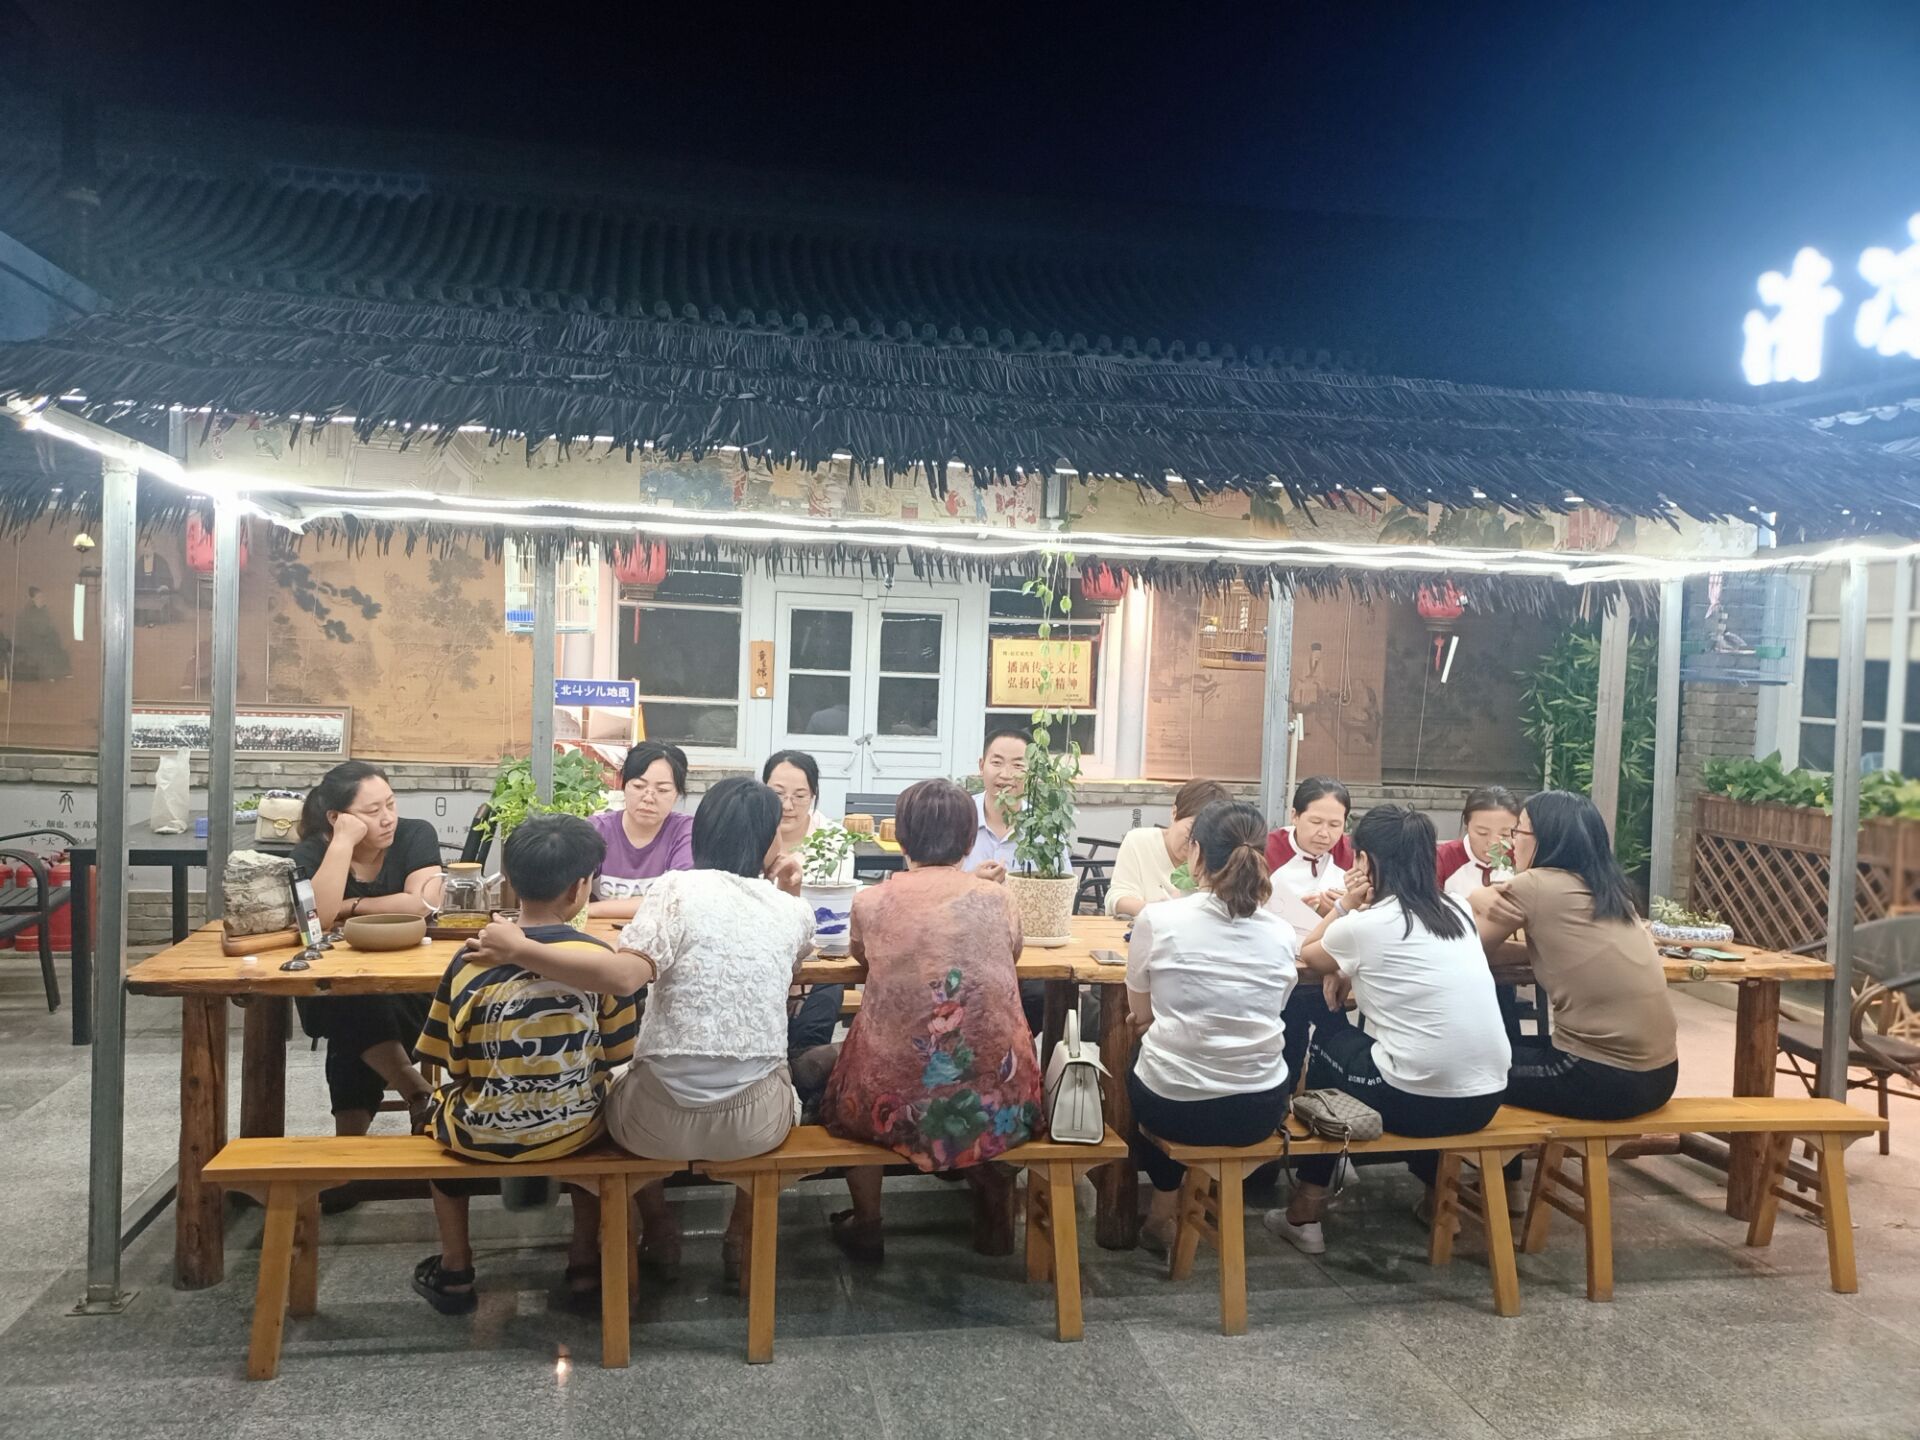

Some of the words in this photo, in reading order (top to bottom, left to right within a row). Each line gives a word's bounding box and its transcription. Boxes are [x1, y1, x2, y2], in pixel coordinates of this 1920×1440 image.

[1007, 677, 1078, 690] 弘扬民精神
[560, 684, 630, 699] 北斗少儿地图
